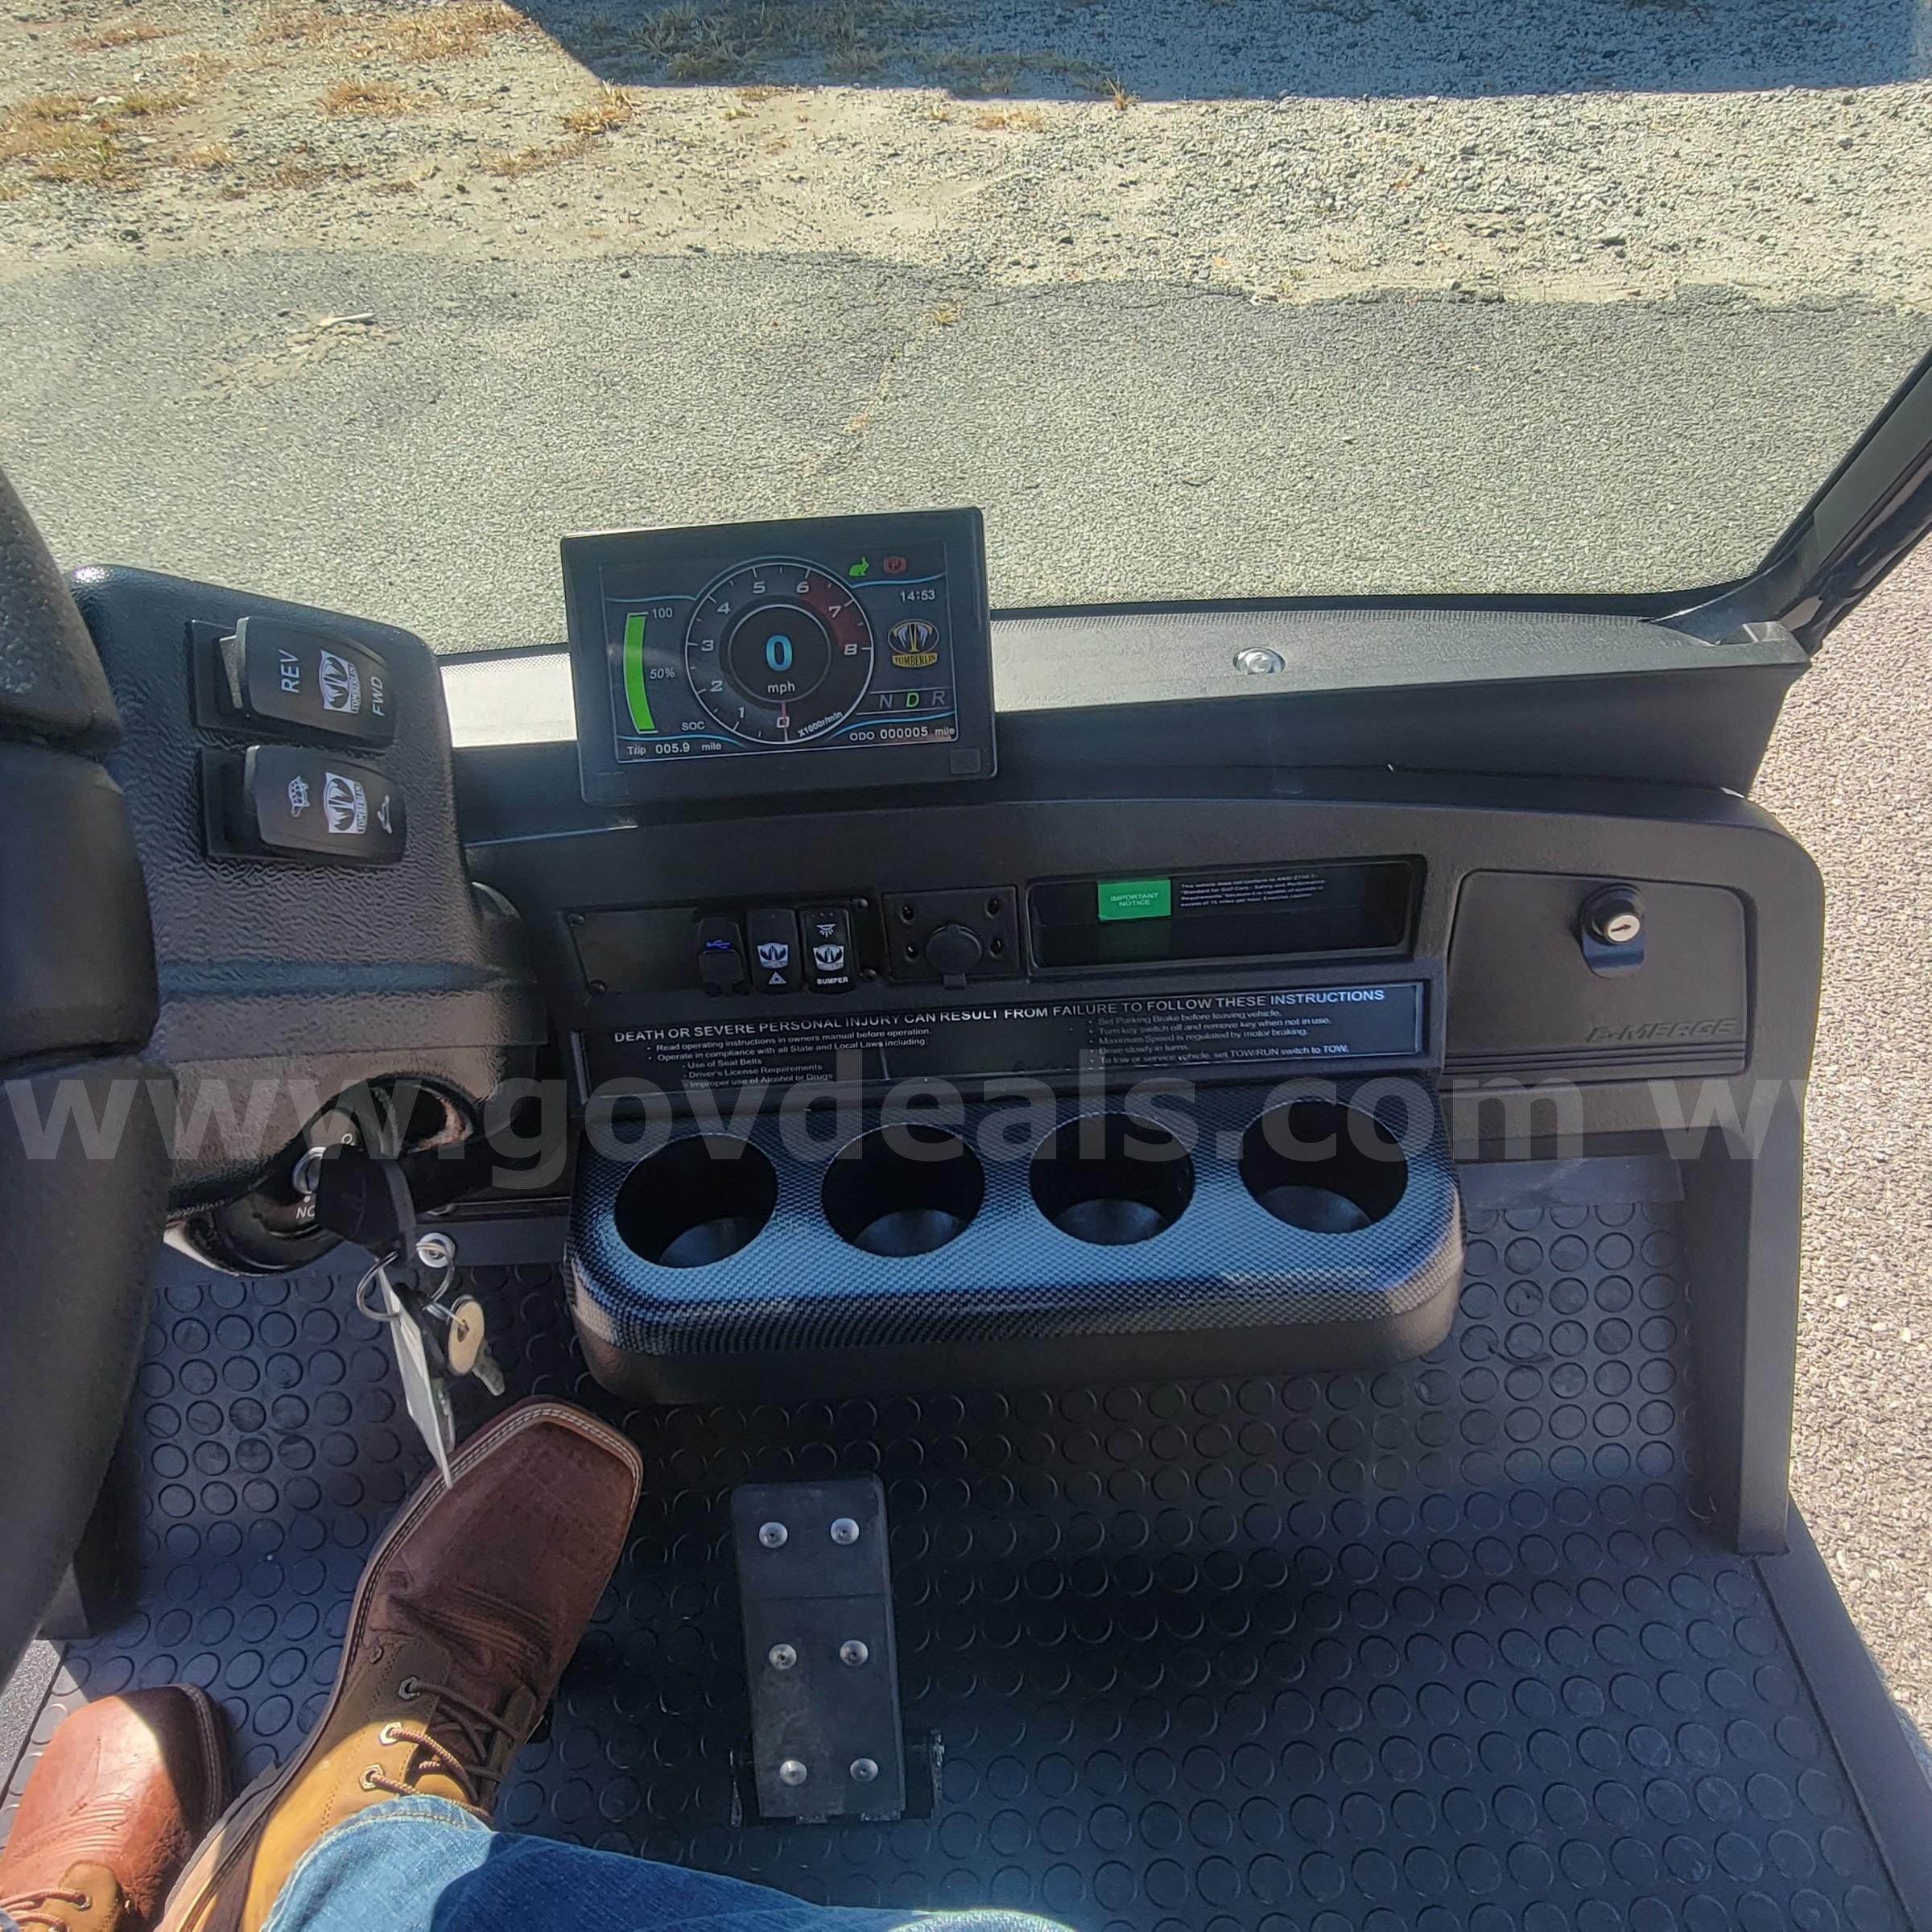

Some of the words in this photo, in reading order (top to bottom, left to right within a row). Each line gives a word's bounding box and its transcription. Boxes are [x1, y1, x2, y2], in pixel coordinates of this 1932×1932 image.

[752, 581, 766, 594] 5
[796, 580, 810, 594] 6
[900, 589, 935, 602] 14:53
[652, 607, 673, 619] 100
[716, 602, 731, 615] 4
[828, 605, 843, 618] 7
[701, 639, 714, 652] 3
[844, 643, 858, 656] 8
[766, 634, 794, 671] 0
[894, 653, 936, 667] TOMBERLIN
[278, 649, 301, 693] REV
[650, 667, 675, 679] 50%
[709, 680, 723, 692] 2
[767, 682, 795, 696] mph
[370, 676, 386, 716] FWD
[879, 694, 893, 709] N
[906, 692, 920, 708] D
[931, 691, 946, 706] R
[737, 707, 745, 719] 1
[681, 721, 706, 731] SOC
[776, 715, 791, 729] 0
[849, 731, 875, 741] ODO
[880, 726, 928, 740] 000005
[934, 726, 955, 736] mile
[626, 745, 646, 757] Trip
[655, 742, 691, 754] 005.9
[701, 741, 722, 751] mile
[1110, 892, 1158, 902] IMPORTANT
[1119, 899, 1151, 907] NOTICE
[817, 976, 849, 985] BUMPER
[614, 1030, 664, 1042] DEATH
[668, 1028, 691, 1038] OR
[694, 1024, 756, 1037] SEVERE
[759, 1018, 842, 1032] PERSONAL
[845, 1014, 898, 1027] INJURY
[904, 1013, 936, 1024] CAN
[1005, 1007, 1048, 1019] FROM
[1053, 1003, 1117, 1016] FAILURE
[1121, 1001, 1142, 1013] TO
[1147, 998, 1212, 1011] FOLLOW
[1216, 995, 1265, 1008] THESE
[1270, 989, 1385, 1005] INSTRUCTIONS
[1153, 1014, 1180, 1023] Brake
[1181, 1013, 1211, 1022] before
[1212, 1011, 1246, 1021] leaving
[1170, 1023, 1183, 1031] off
[1183, 1022, 1202, 1030] and
[1240, 1020, 1257, 1030] key
[1257, 1019, 1283, 1027] when
[1285, 1018, 1301, 1026] not
[656, 1043, 679, 1051] Read
[682, 1041, 724, 1051] operating
[725, 1037, 776, 1047] instructions
[778, 1035, 786, 1043] in
[788, 1035, 820, 1043] owners
[822, 1032, 855, 1041] manual
[857, 1029, 886, 1038] before
[887, 1027, 932, 1038] operation.
[1185, 1030, 1228, 1042] regulated
[1230, 1030, 1242, 1039] by
[1243, 1029, 1270, 1037] motor
[657, 1052, 693, 1063] Operate
[695, 1051, 704, 1059] in
[705, 1048, 755, 1059] compliance
[757, 1046, 776, 1055] with
[778, 1045, 789, 1053] all
[790, 1043, 814, 1053] State
[815, 1042, 832, 1051] and
[834, 1041, 858, 1050] Local
[860, 1040, 884, 1048] Laws
[1281, 1046, 1310, 1055] switch
[1322, 1044, 1349, 1053] TOW.
[740, 1058, 763, 1066] Belts
[689, 1071, 723, 1079] Driver's
[724, 1067, 758, 1076] License
[760, 1063, 823, 1074] Requirements
[690, 1079, 729, 1088] Improper
[762, 1075, 794, 1084] Alcohol
[806, 1072, 833, 1082] Drugs
